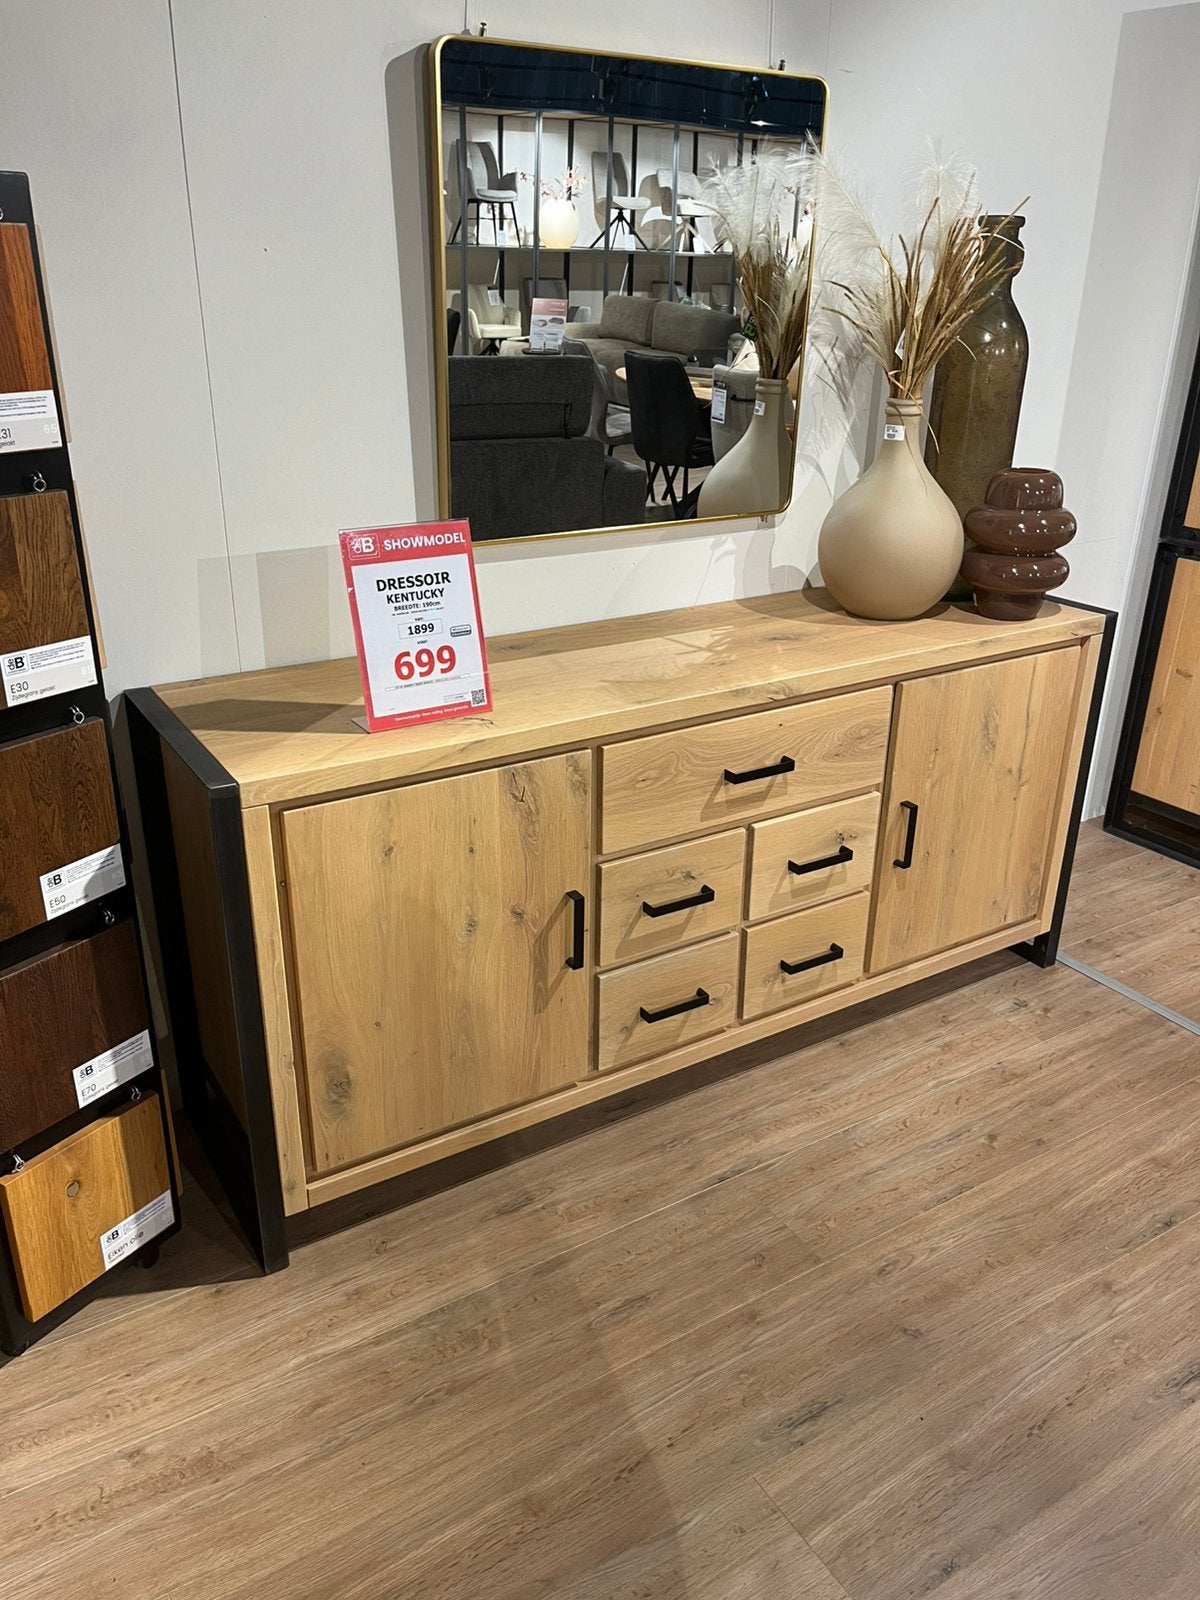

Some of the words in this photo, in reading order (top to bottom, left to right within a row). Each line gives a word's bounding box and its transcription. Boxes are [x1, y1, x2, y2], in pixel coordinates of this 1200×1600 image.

[0, 428, 12, 439] 31
[383, 532, 466, 551] SHOWMODEL
[376, 571, 451, 592] DRESSOIR
[386, 588, 445, 604] KENTUCKY
[422, 600, 441, 608] 190cm
[407, 622, 435, 636] 1899
[394, 644, 457, 681] 699
[10, 681, 29, 694] E30
[49, 894, 67, 908] E50
[81, 1083, 97, 1097] E70
[107, 1242, 129, 1260] Eiken
[130, 1231, 145, 1244] olie
